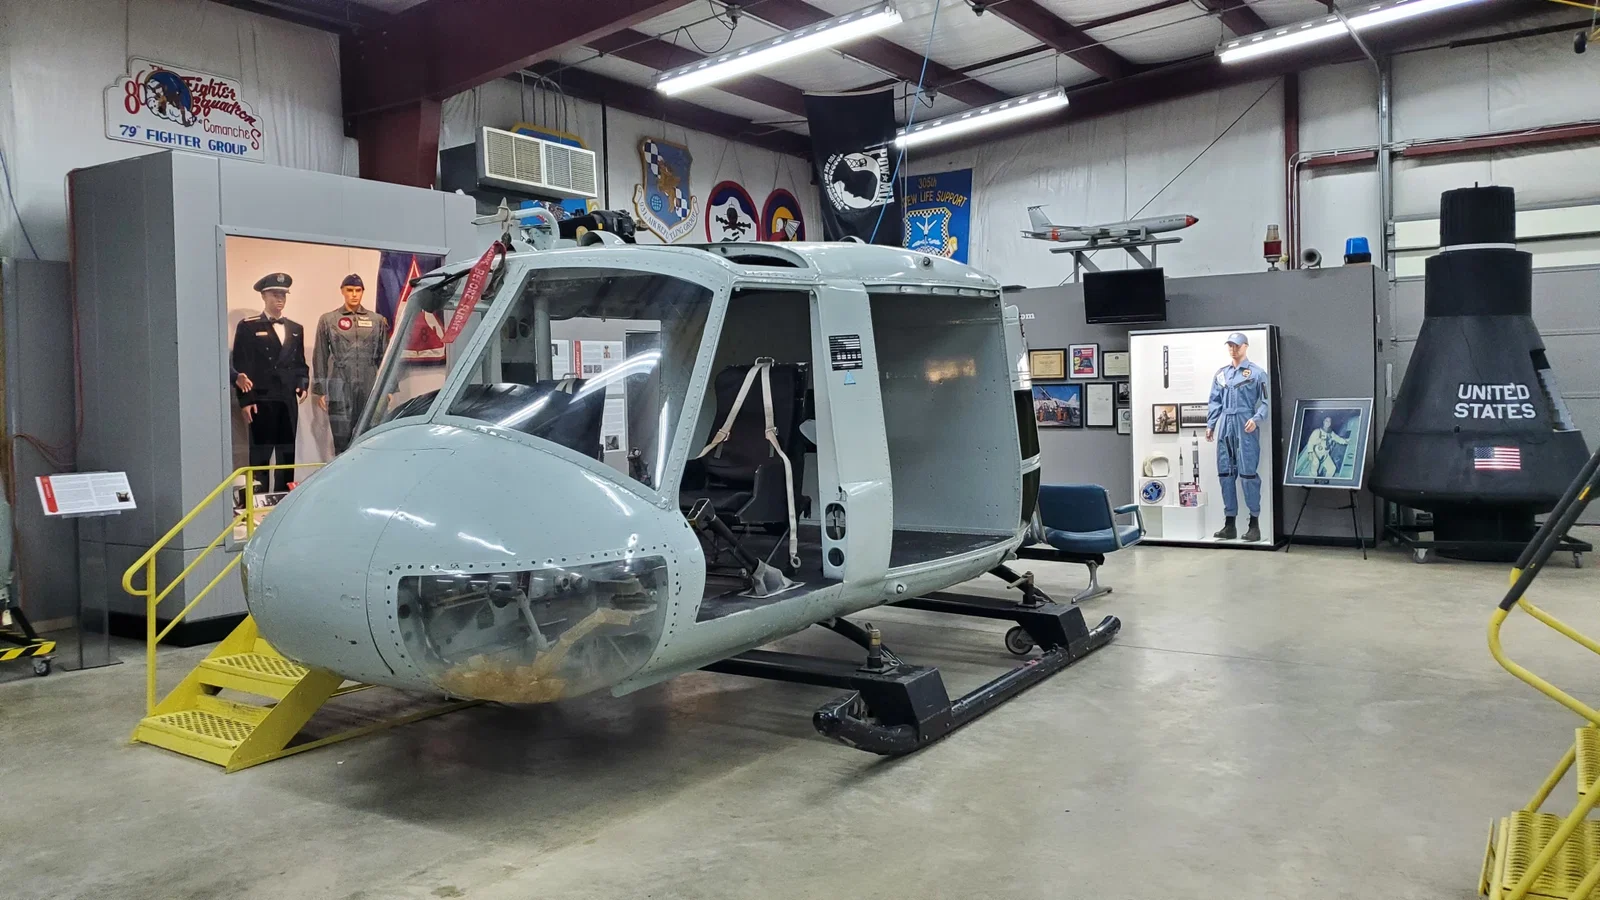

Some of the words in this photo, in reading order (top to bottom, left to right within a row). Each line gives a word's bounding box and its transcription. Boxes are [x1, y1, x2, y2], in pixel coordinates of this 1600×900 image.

[181, 76, 237, 101] Fighter
[192, 96, 257, 128] Squadron
[146, 129, 201, 149] FIGHTER
[208, 139, 248, 156] GROUP
[870, 181, 895, 208] MIA
[918, 176, 937, 189] 305th
[920, 191, 935, 203] LIFE
[936, 190, 968, 208] SUPPORT
[464, 267, 485, 300] BEFORE
[1458, 383, 1530, 400] UNITED
[1454, 402, 1536, 419] STATES
